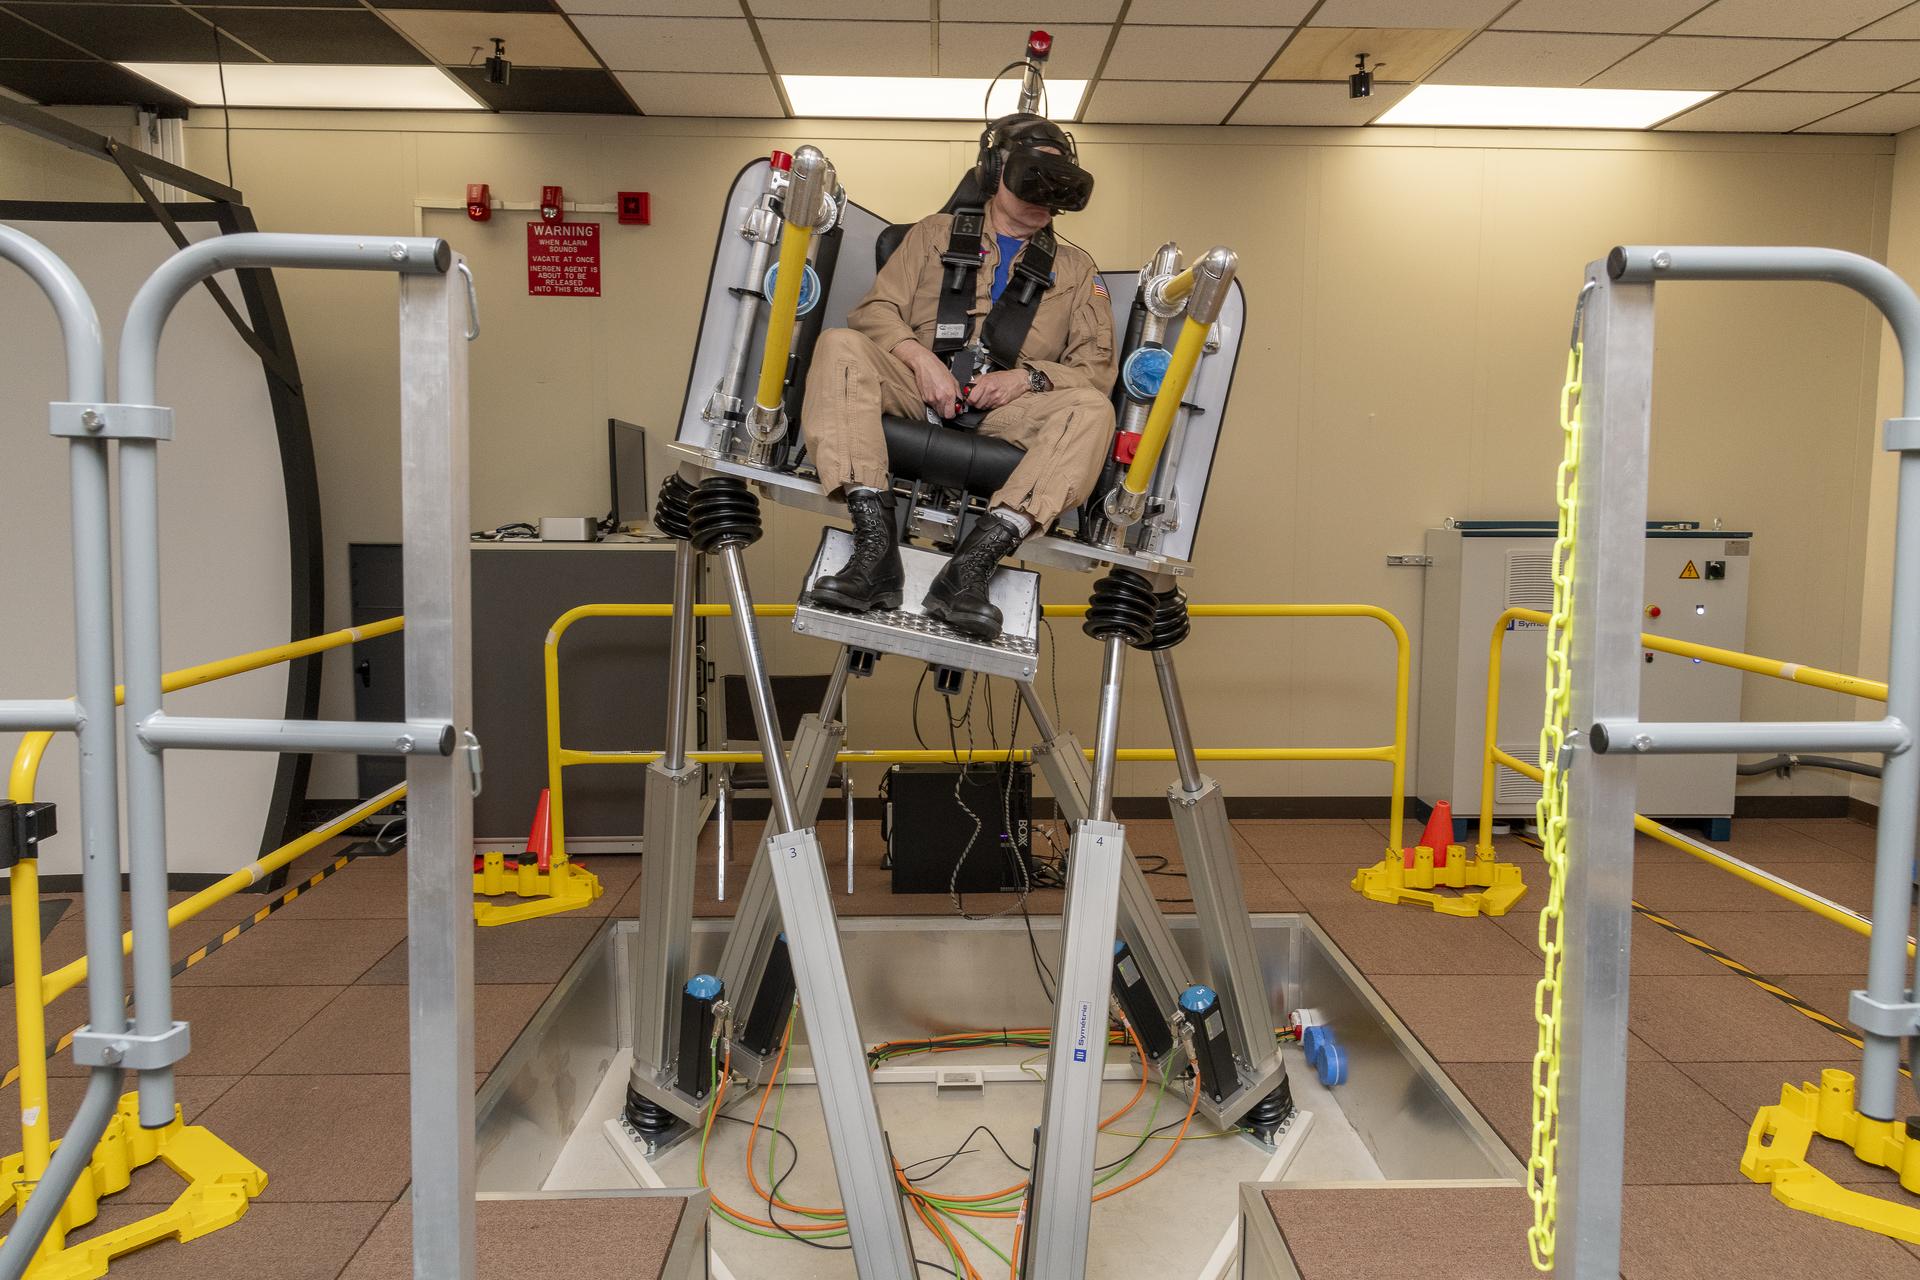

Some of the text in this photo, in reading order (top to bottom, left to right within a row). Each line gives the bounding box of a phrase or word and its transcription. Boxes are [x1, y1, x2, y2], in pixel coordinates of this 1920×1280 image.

[534, 226, 593, 236] WARNING
[1018, 819, 1028, 847] BOXX
[1096, 836, 1104, 847] 4
[790, 847, 797, 859] 3
